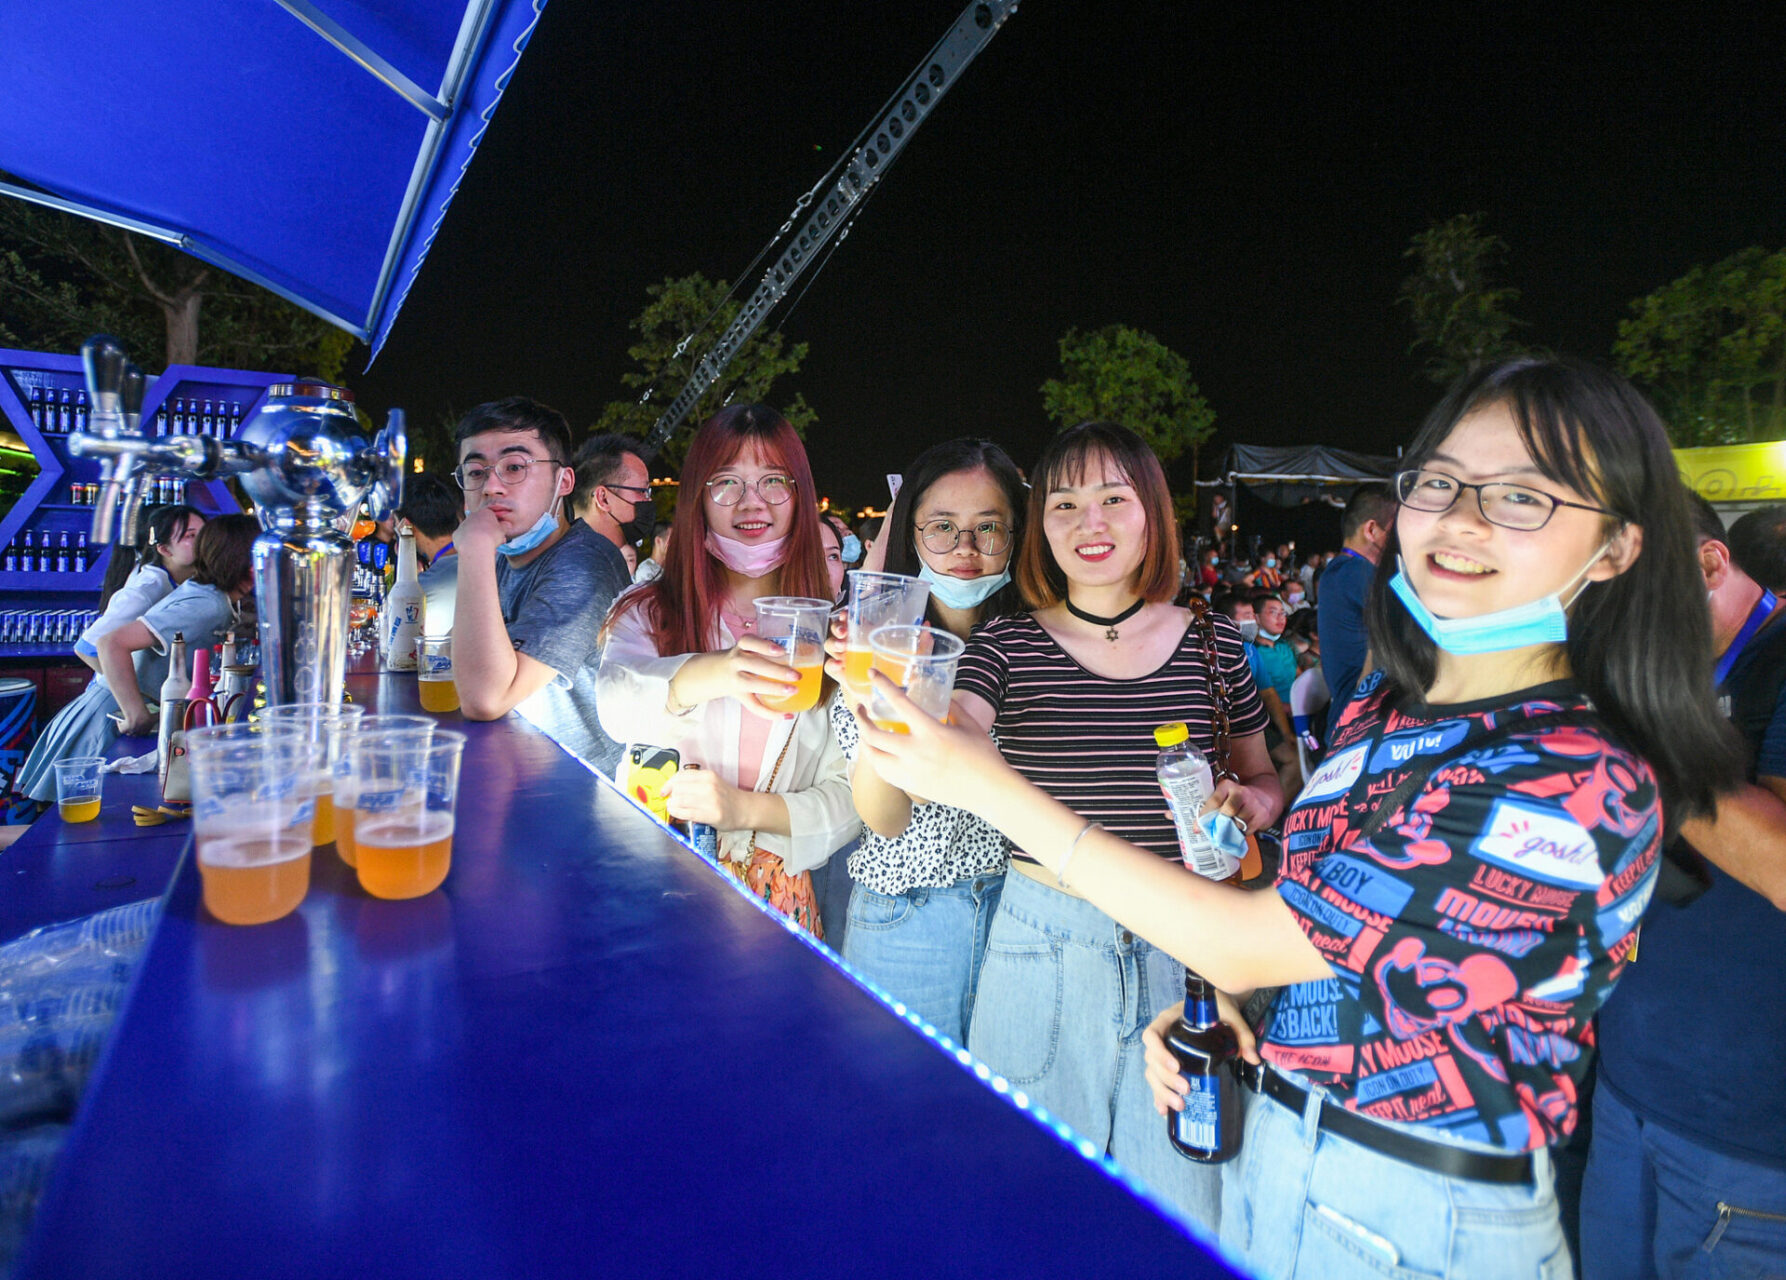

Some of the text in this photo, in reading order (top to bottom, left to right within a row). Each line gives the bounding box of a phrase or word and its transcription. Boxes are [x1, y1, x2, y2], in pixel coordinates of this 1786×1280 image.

[1325, 858, 1374, 895] BOY
[1473, 864, 1533, 900] LUCKY
[1290, 978, 1344, 1007] MOUSE
[1287, 1004, 1338, 1038] BACK!
[1374, 1030, 1449, 1070] MOUSE
